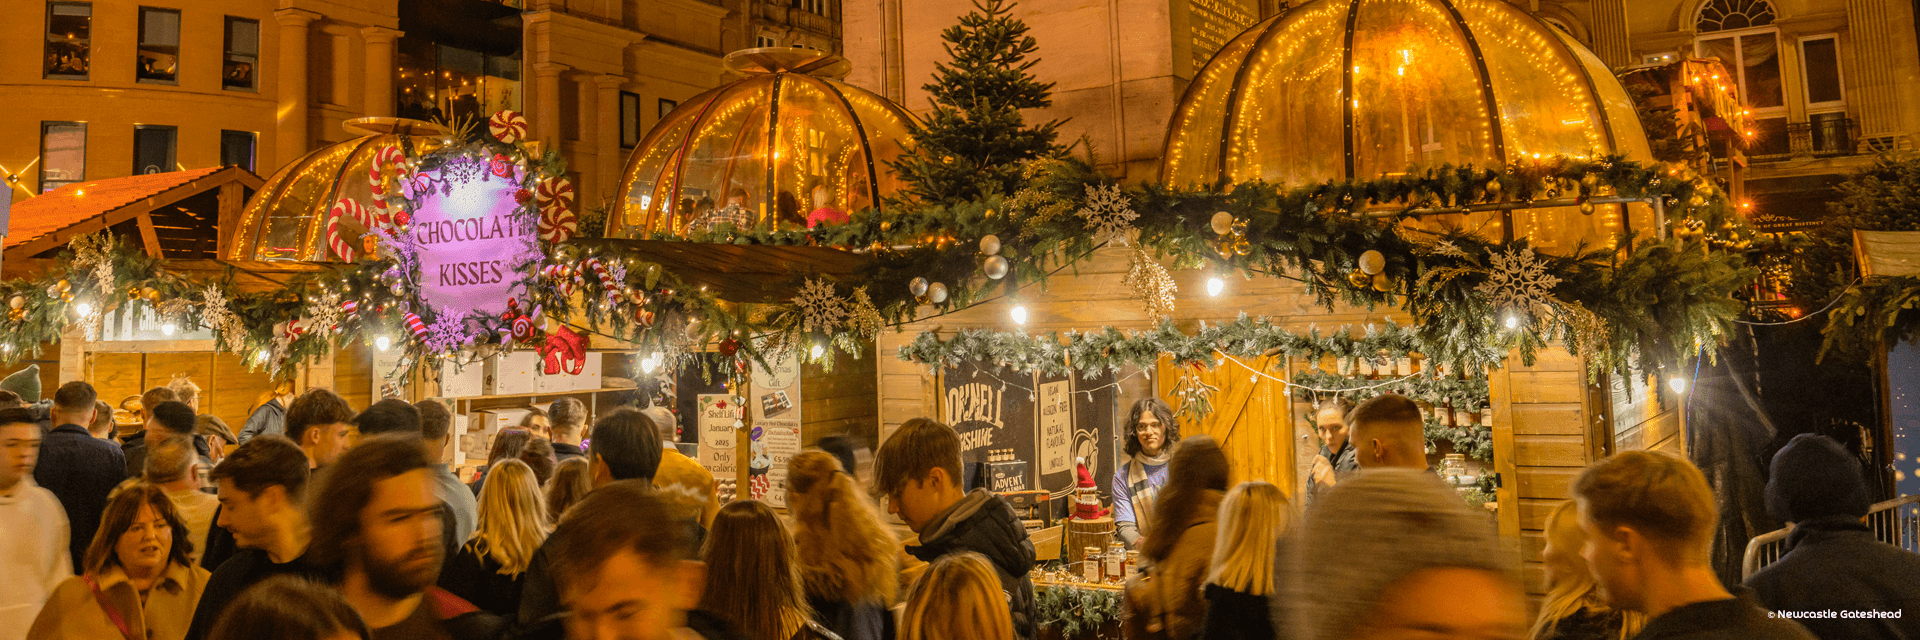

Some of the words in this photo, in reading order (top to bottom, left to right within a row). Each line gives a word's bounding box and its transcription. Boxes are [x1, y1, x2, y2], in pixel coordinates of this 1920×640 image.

[439, 260, 503, 287] KISSES
[708, 409, 724, 419] Shelf
[708, 424, 734, 434] January
[713, 452, 732, 463] Only
[712, 463, 736, 473] calorie
[994, 474, 1023, 490] ADVENT
